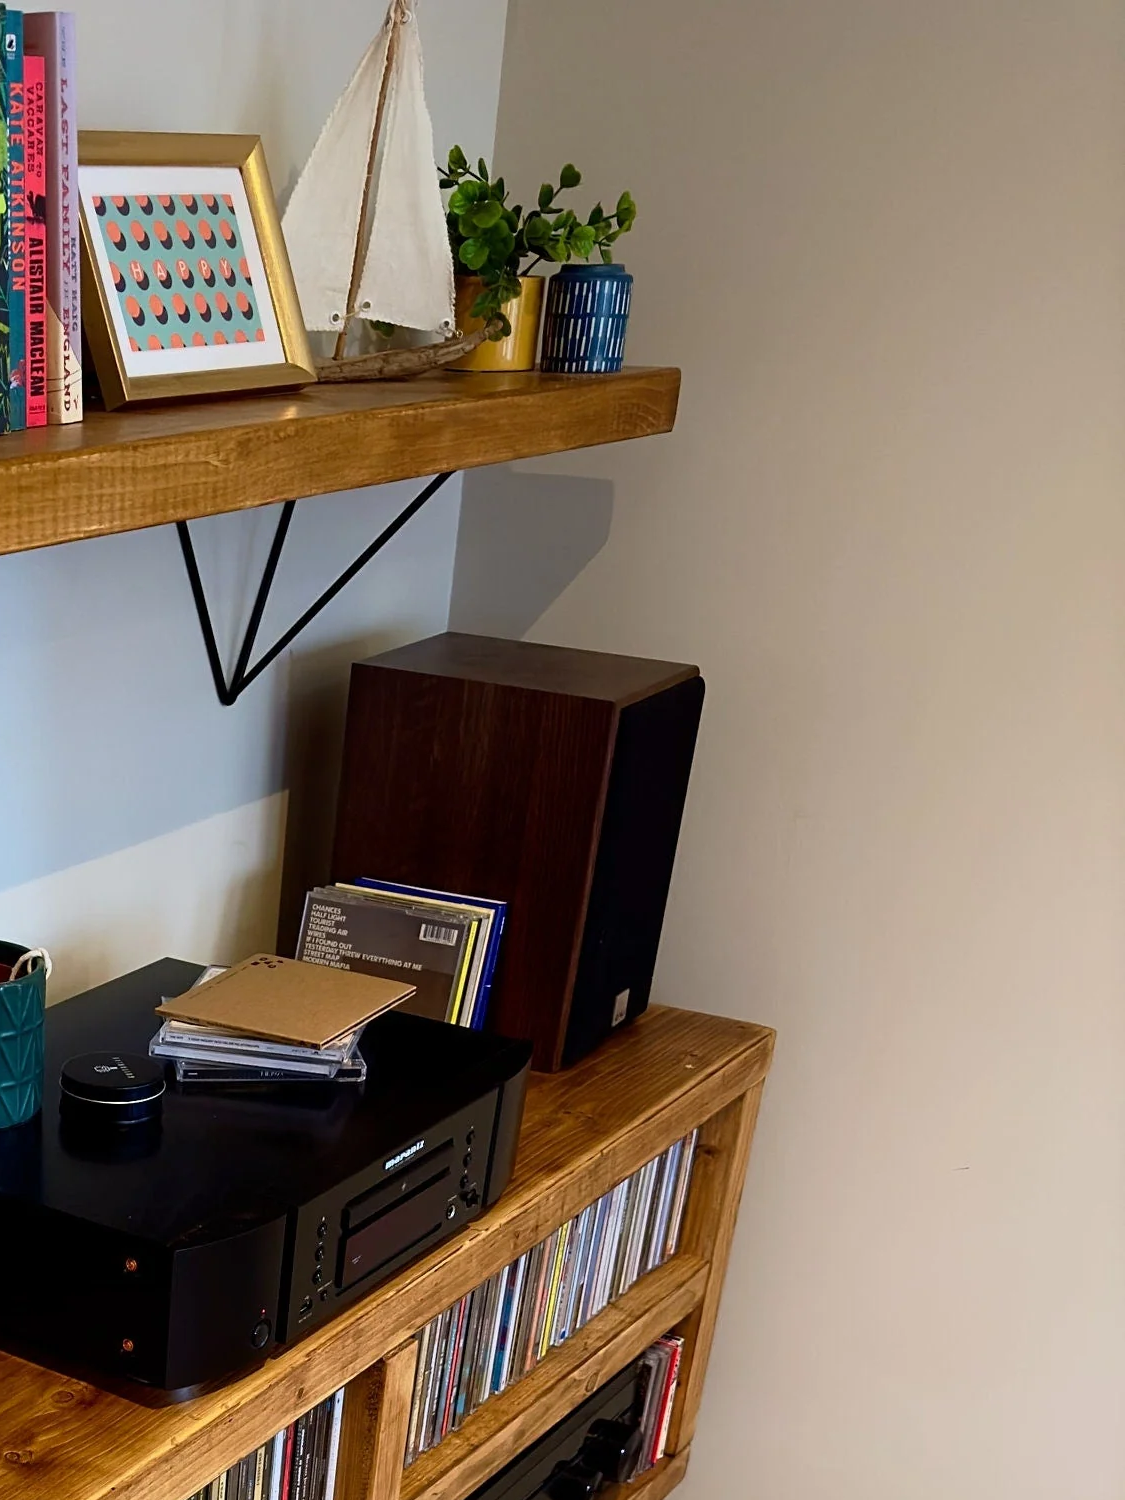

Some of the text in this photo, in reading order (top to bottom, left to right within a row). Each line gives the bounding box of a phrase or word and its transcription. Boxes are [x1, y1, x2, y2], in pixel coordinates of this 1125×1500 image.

[27, 86, 35, 173] VACCARES
[35, 82, 44, 178] CARAVAN TO
[60, 78, 69, 155] LAST
[9, 83, 26, 291] KATE ATKINSON
[61, 164, 71, 275] FAMILY
[28, 237, 45, 315] ALISTAIR
[70, 237, 78, 284] MATT
[30, 320, 45, 397] MACLEAN
[62, 307, 71, 412] ENGLAND
[310, 917, 335, 926] TOURIST
[311, 911, 347, 922] HALF LIGHT
[312, 904, 341, 914] CHANCES
[307, 930, 326, 938] WIRES
[308, 924, 348, 937] TRADING AIR
[315, 938, 338, 948] FOUND
[303, 949, 341, 961] STREET MAP
[305, 943, 338, 954] YESTERDAY
[339, 949, 361, 959] THREW
[362, 953, 402, 967] EVERYTHING
[329, 961, 350, 970] MAFIA
[385, 1139, 425, 1170] marantz
